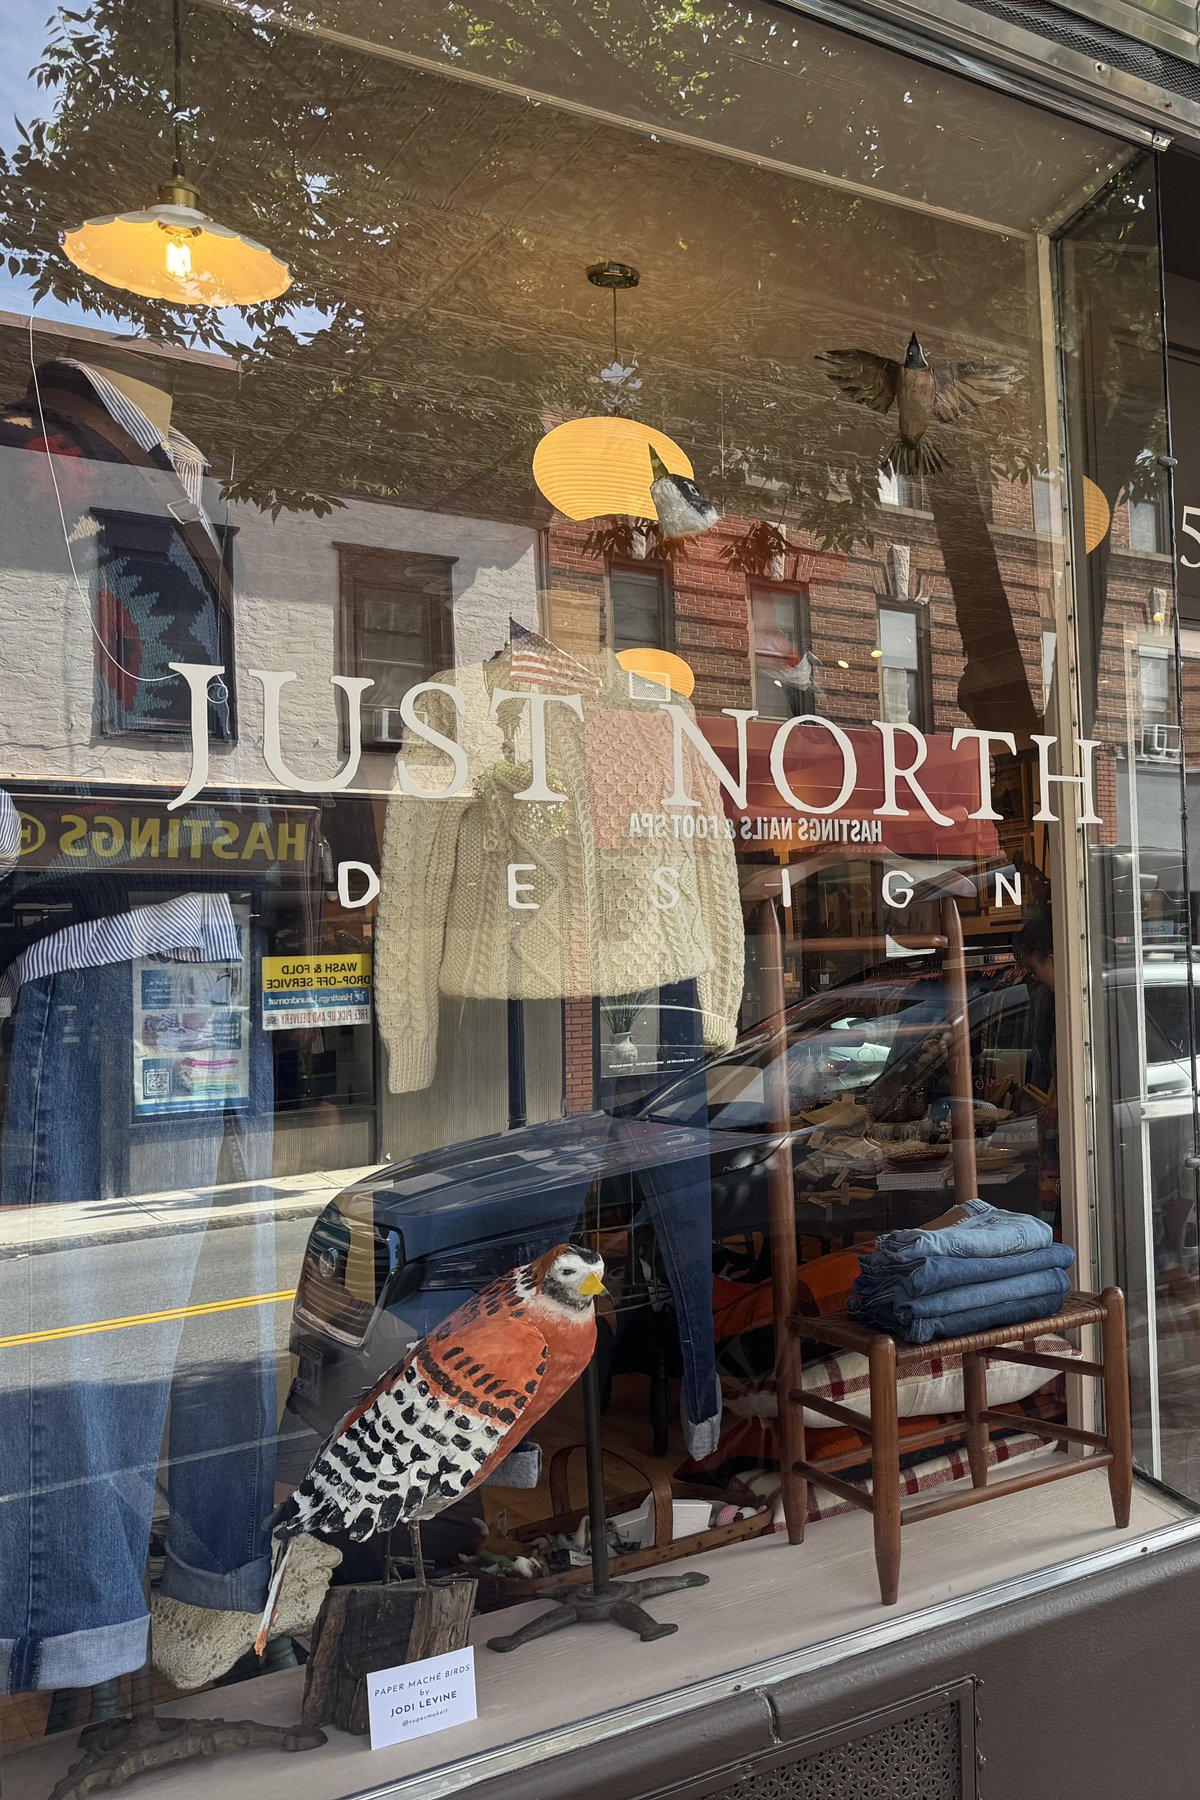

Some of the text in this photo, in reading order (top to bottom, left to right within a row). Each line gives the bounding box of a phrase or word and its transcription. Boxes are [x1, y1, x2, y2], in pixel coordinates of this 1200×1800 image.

[167, 661, 1103, 826] JUST NORTH
[374, 1664, 470, 1697] PAPER MACHÉ BIRDS
[419, 1688, 430, 1697] by
[390, 1690, 457, 1718] JODI LEVINE
